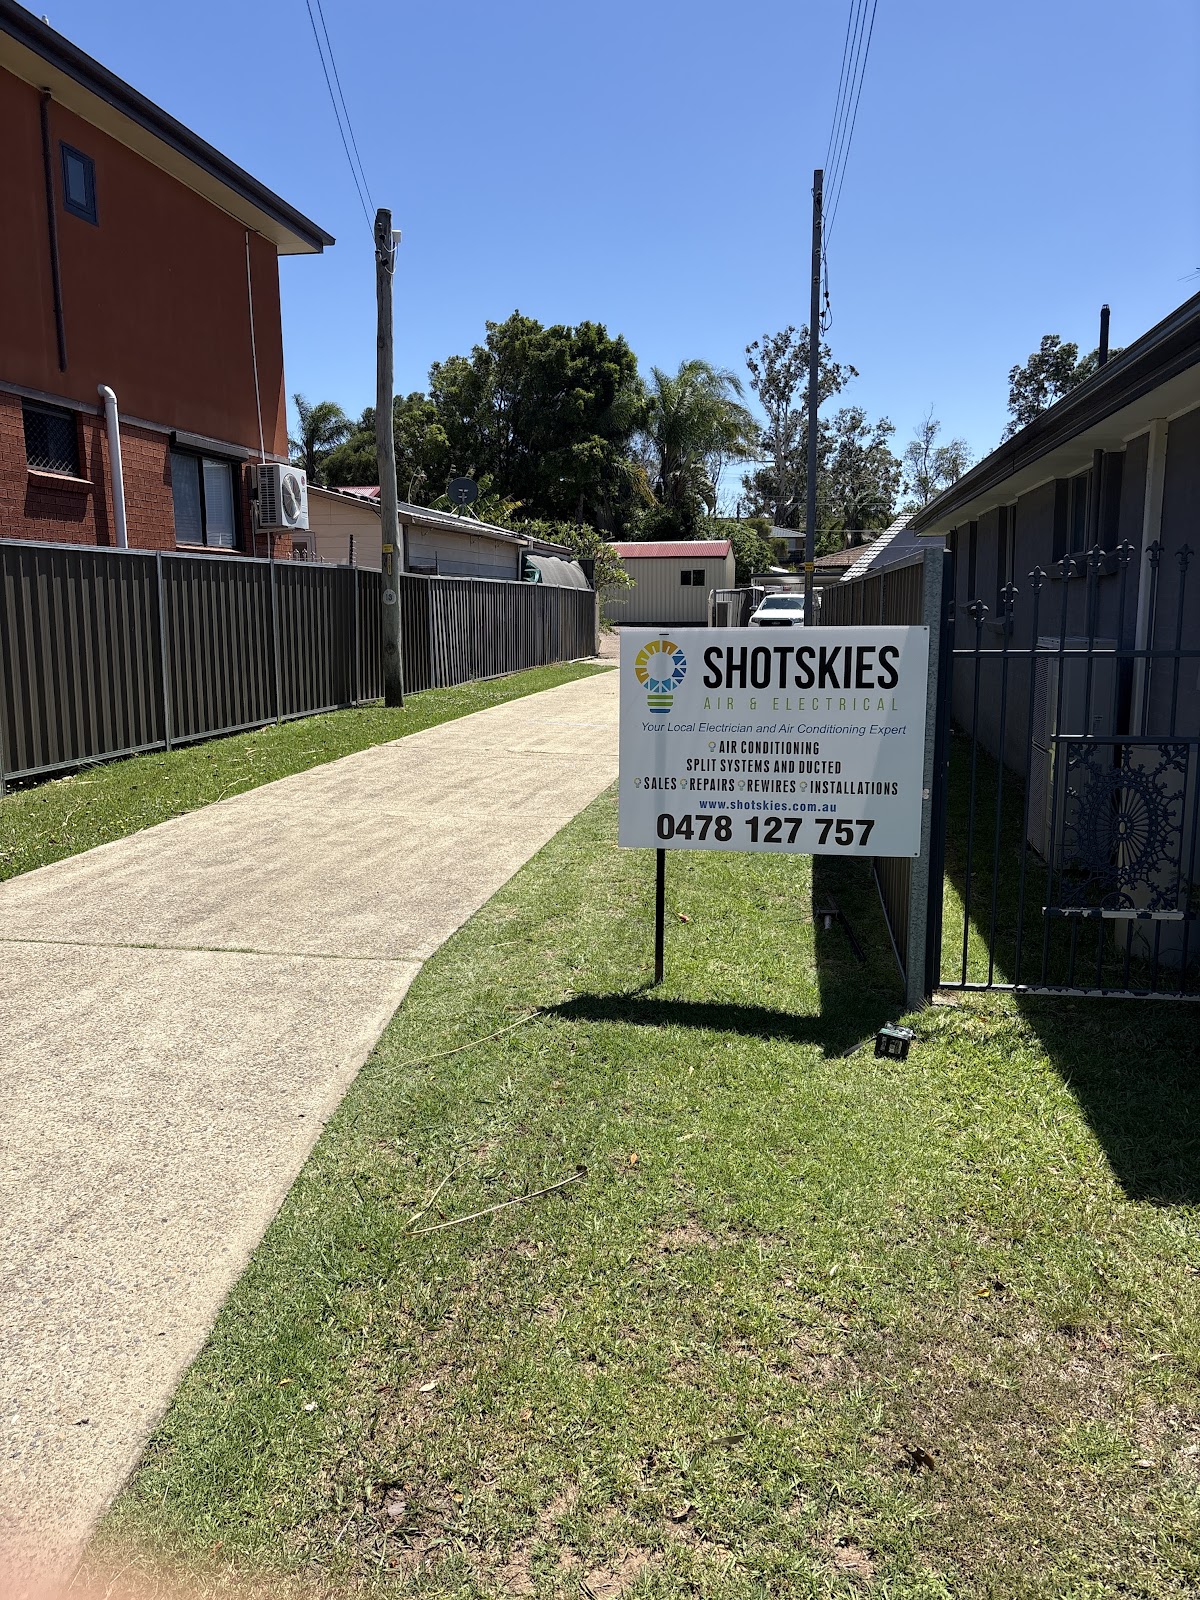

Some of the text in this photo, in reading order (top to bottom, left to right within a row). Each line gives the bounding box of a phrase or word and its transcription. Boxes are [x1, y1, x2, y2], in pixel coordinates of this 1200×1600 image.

[702, 645, 900, 690] SHOTSKIES
[703, 696, 898, 712] AIR & ELECTRICAL
[641, 721, 906, 737] Your Local Electrician and Air Conditioning Expert
[718, 740, 820, 755] AIR CONDITIONING
[686, 758, 842, 775] SPLIT SYSTEMS AND DUCTED
[643, 777, 899, 796] SALES REPAIRS REWIRES INSTALLATIONS
[698, 799, 837, 813] www.shotskies.com.au
[656, 813, 875, 847] 0478 127 757
